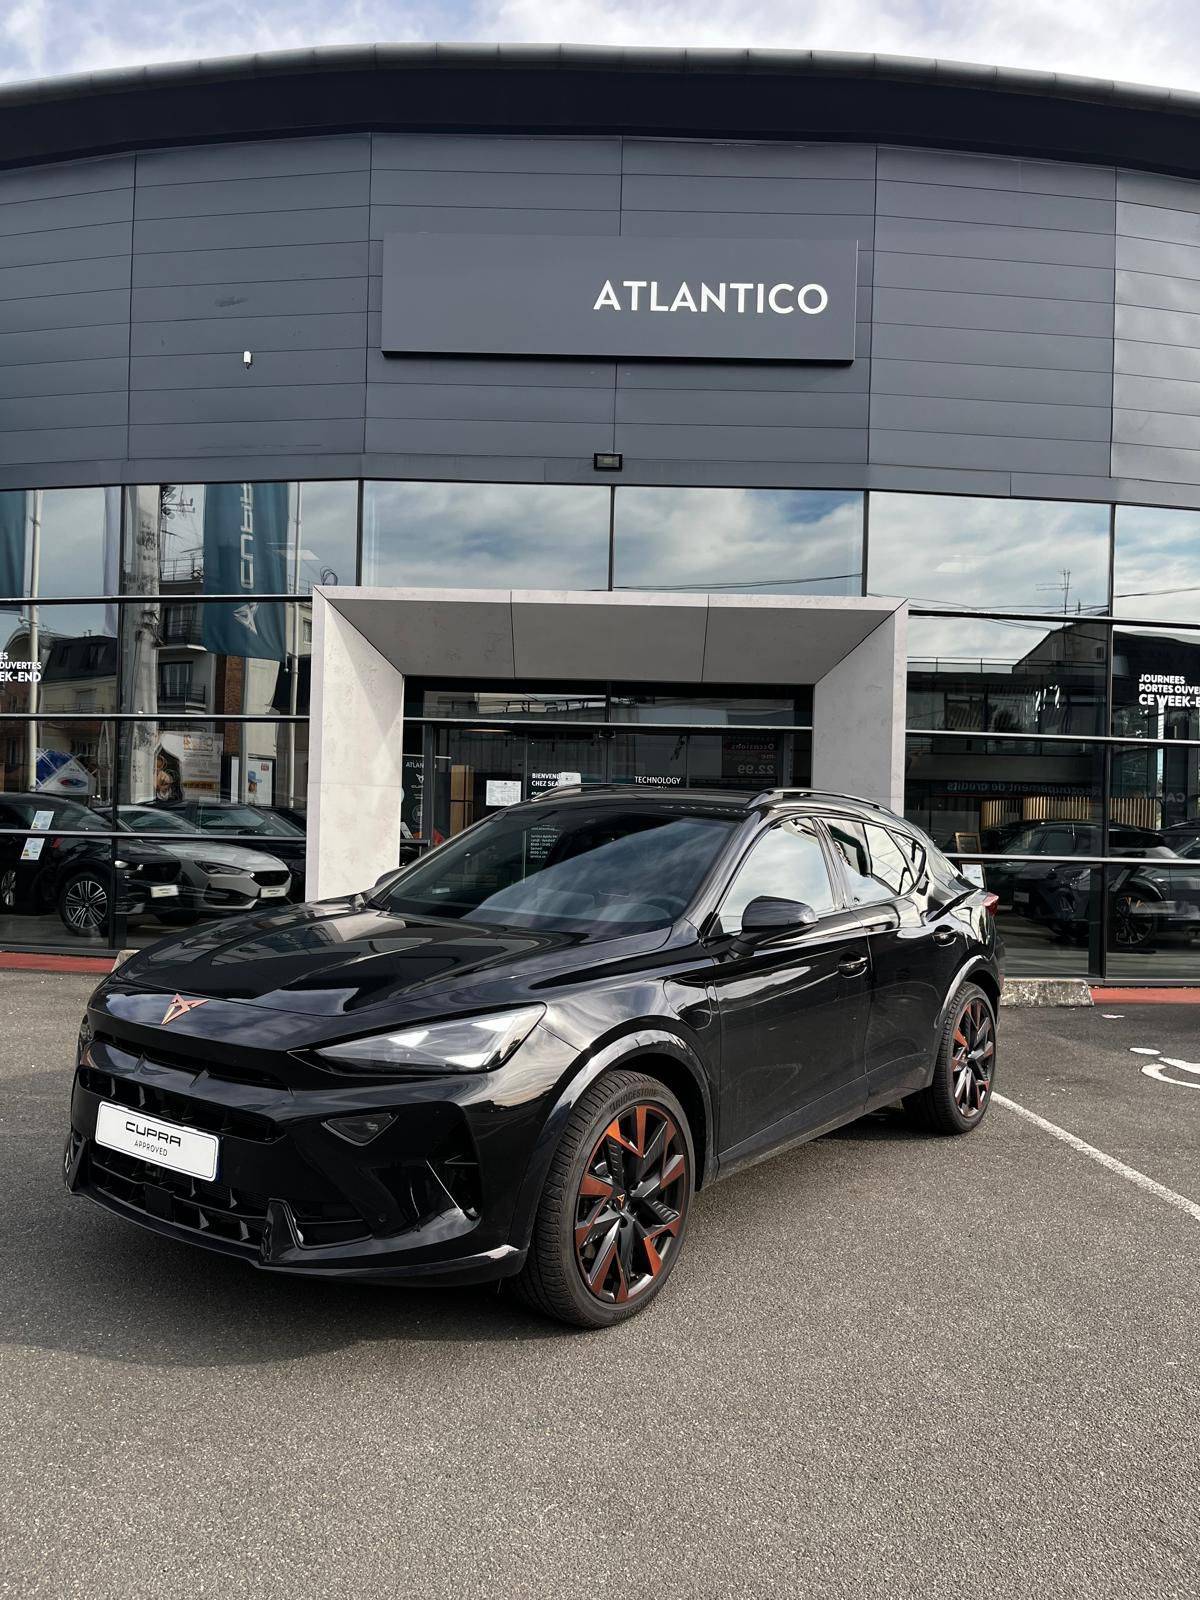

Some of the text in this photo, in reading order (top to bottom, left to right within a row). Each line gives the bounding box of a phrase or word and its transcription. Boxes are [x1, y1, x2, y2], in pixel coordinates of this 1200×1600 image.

[593, 279, 828, 314] ATLANTICO
[0, 661, 42, 670] OUVERTES
[1139, 674, 1186, 684] JOURNEES
[1139, 684, 1174, 693] PORTES
[1139, 694, 1155, 706] CE
[634, 775, 681, 785] TECHNOLOGY
[125, 1121, 182, 1148] CUPRA
[134, 1140, 168, 1157] APPROVED
